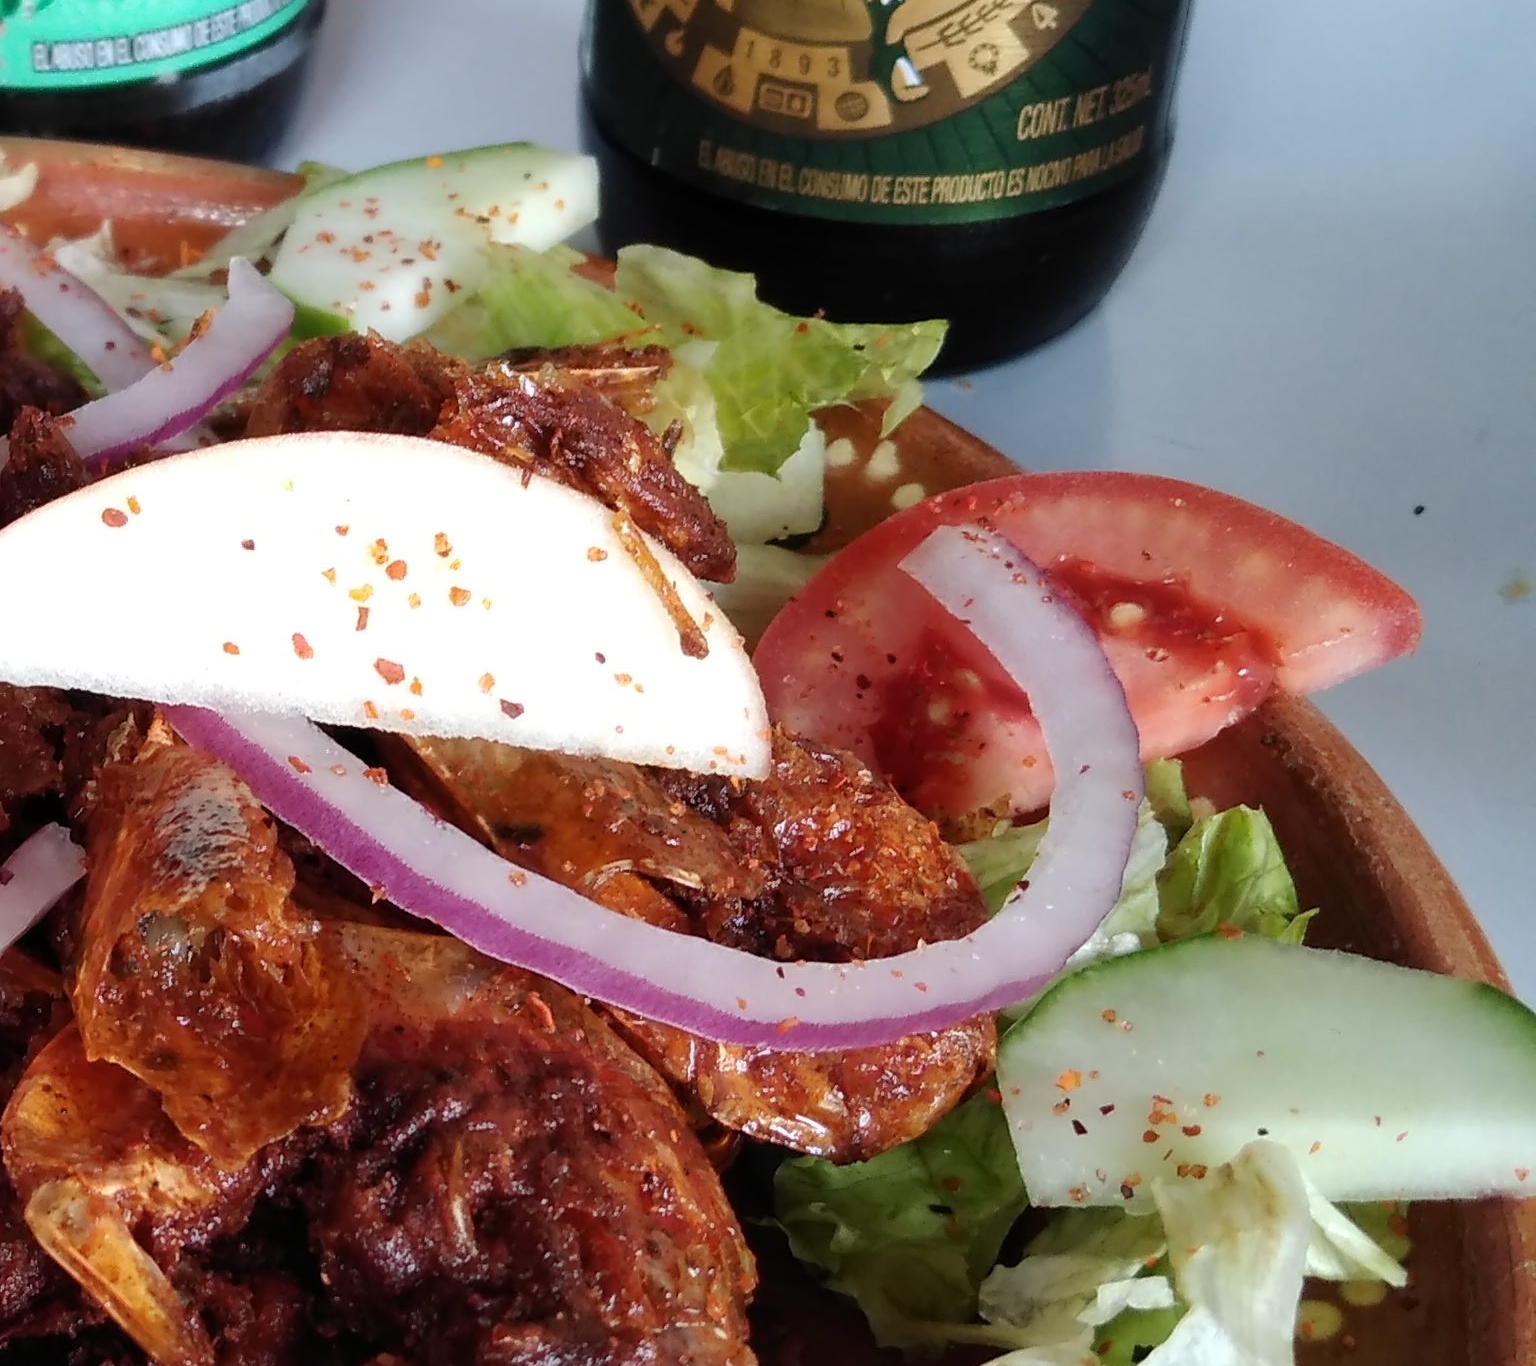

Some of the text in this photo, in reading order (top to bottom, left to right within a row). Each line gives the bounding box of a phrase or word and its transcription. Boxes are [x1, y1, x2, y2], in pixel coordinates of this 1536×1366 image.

[798, 167, 868, 203] CONSUMO
[870, 175, 892, 204] DE
[893, 175, 930, 205] ESTE
[930, 169, 1006, 205] PRODUCTO
[1007, 168, 1027, 198] ES
